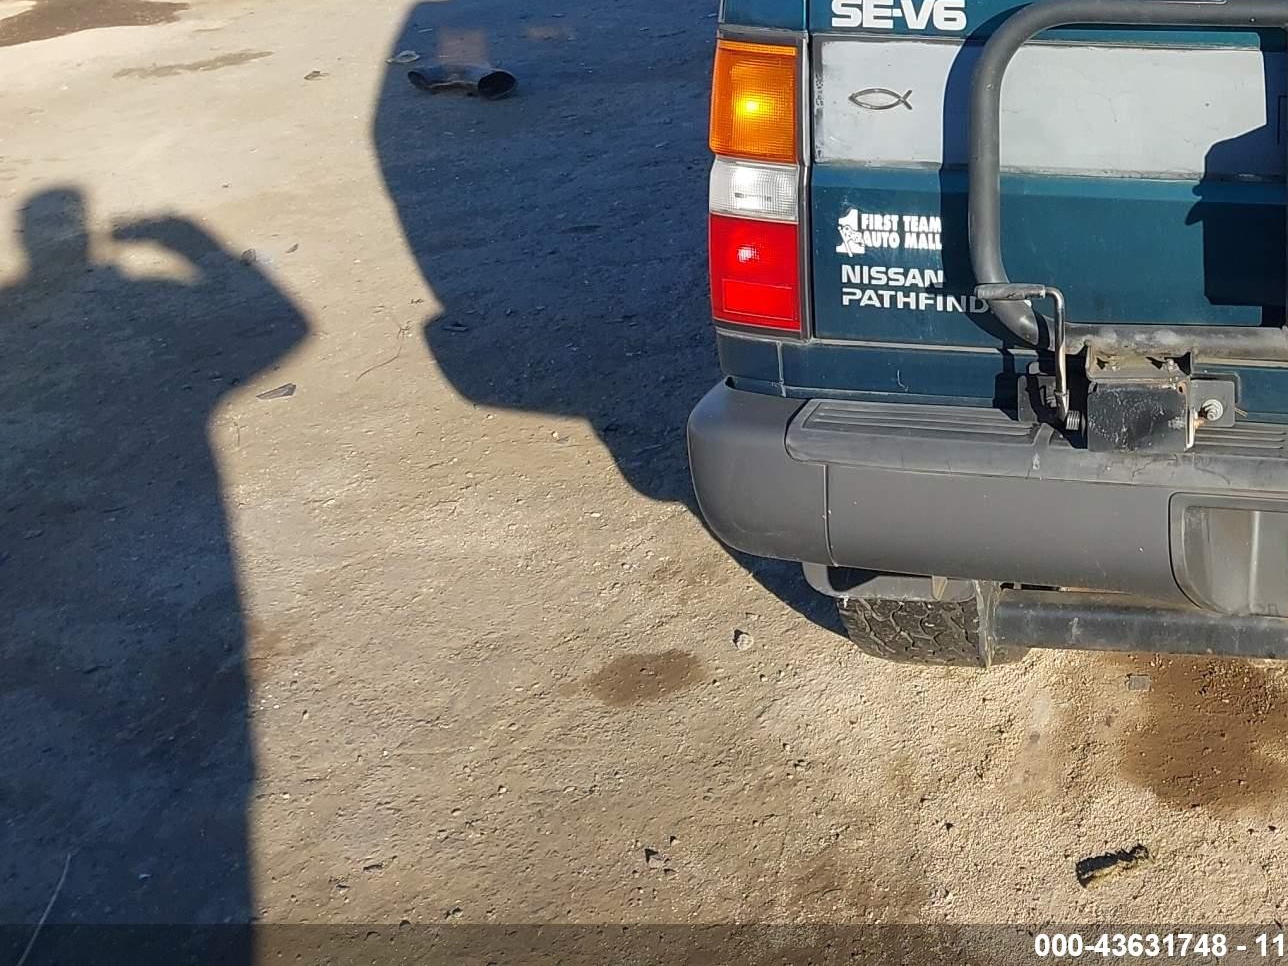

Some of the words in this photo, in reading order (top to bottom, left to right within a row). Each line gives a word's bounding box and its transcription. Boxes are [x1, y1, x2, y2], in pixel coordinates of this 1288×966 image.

[861, 213, 899, 231] FIRST
[902, 215, 942, 232] TEAM
[863, 231, 900, 248] AUTO
[904, 232, 943, 250] MALL
[841, 264, 944, 288] NISSAN
[842, 288, 1031, 314] PATHFIND
